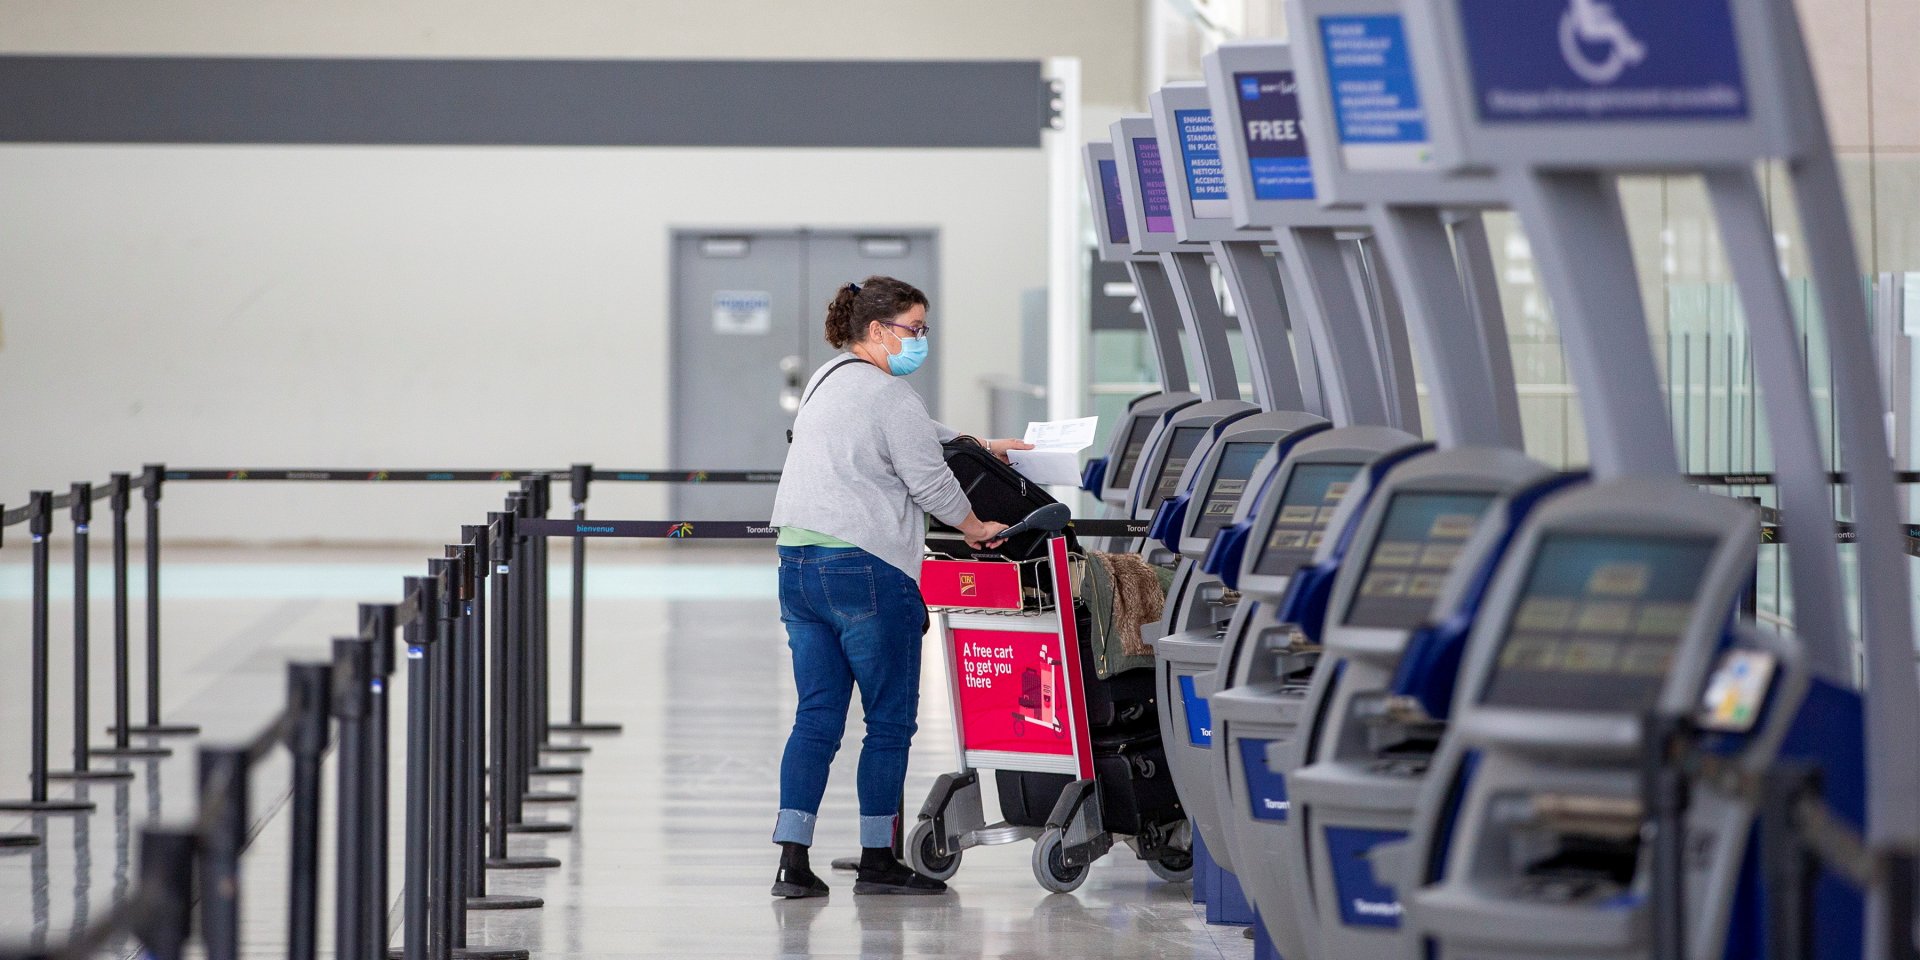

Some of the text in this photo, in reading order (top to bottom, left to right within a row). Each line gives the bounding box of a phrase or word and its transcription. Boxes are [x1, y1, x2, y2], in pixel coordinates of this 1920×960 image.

[1248, 120, 1297, 141] FREE
[1188, 143, 1196, 151] IN
[963, 642, 1014, 659] A free cart
[964, 658, 1012, 677] to get you
[966, 673, 992, 688] there
[1200, 727, 1212, 736] Tor
